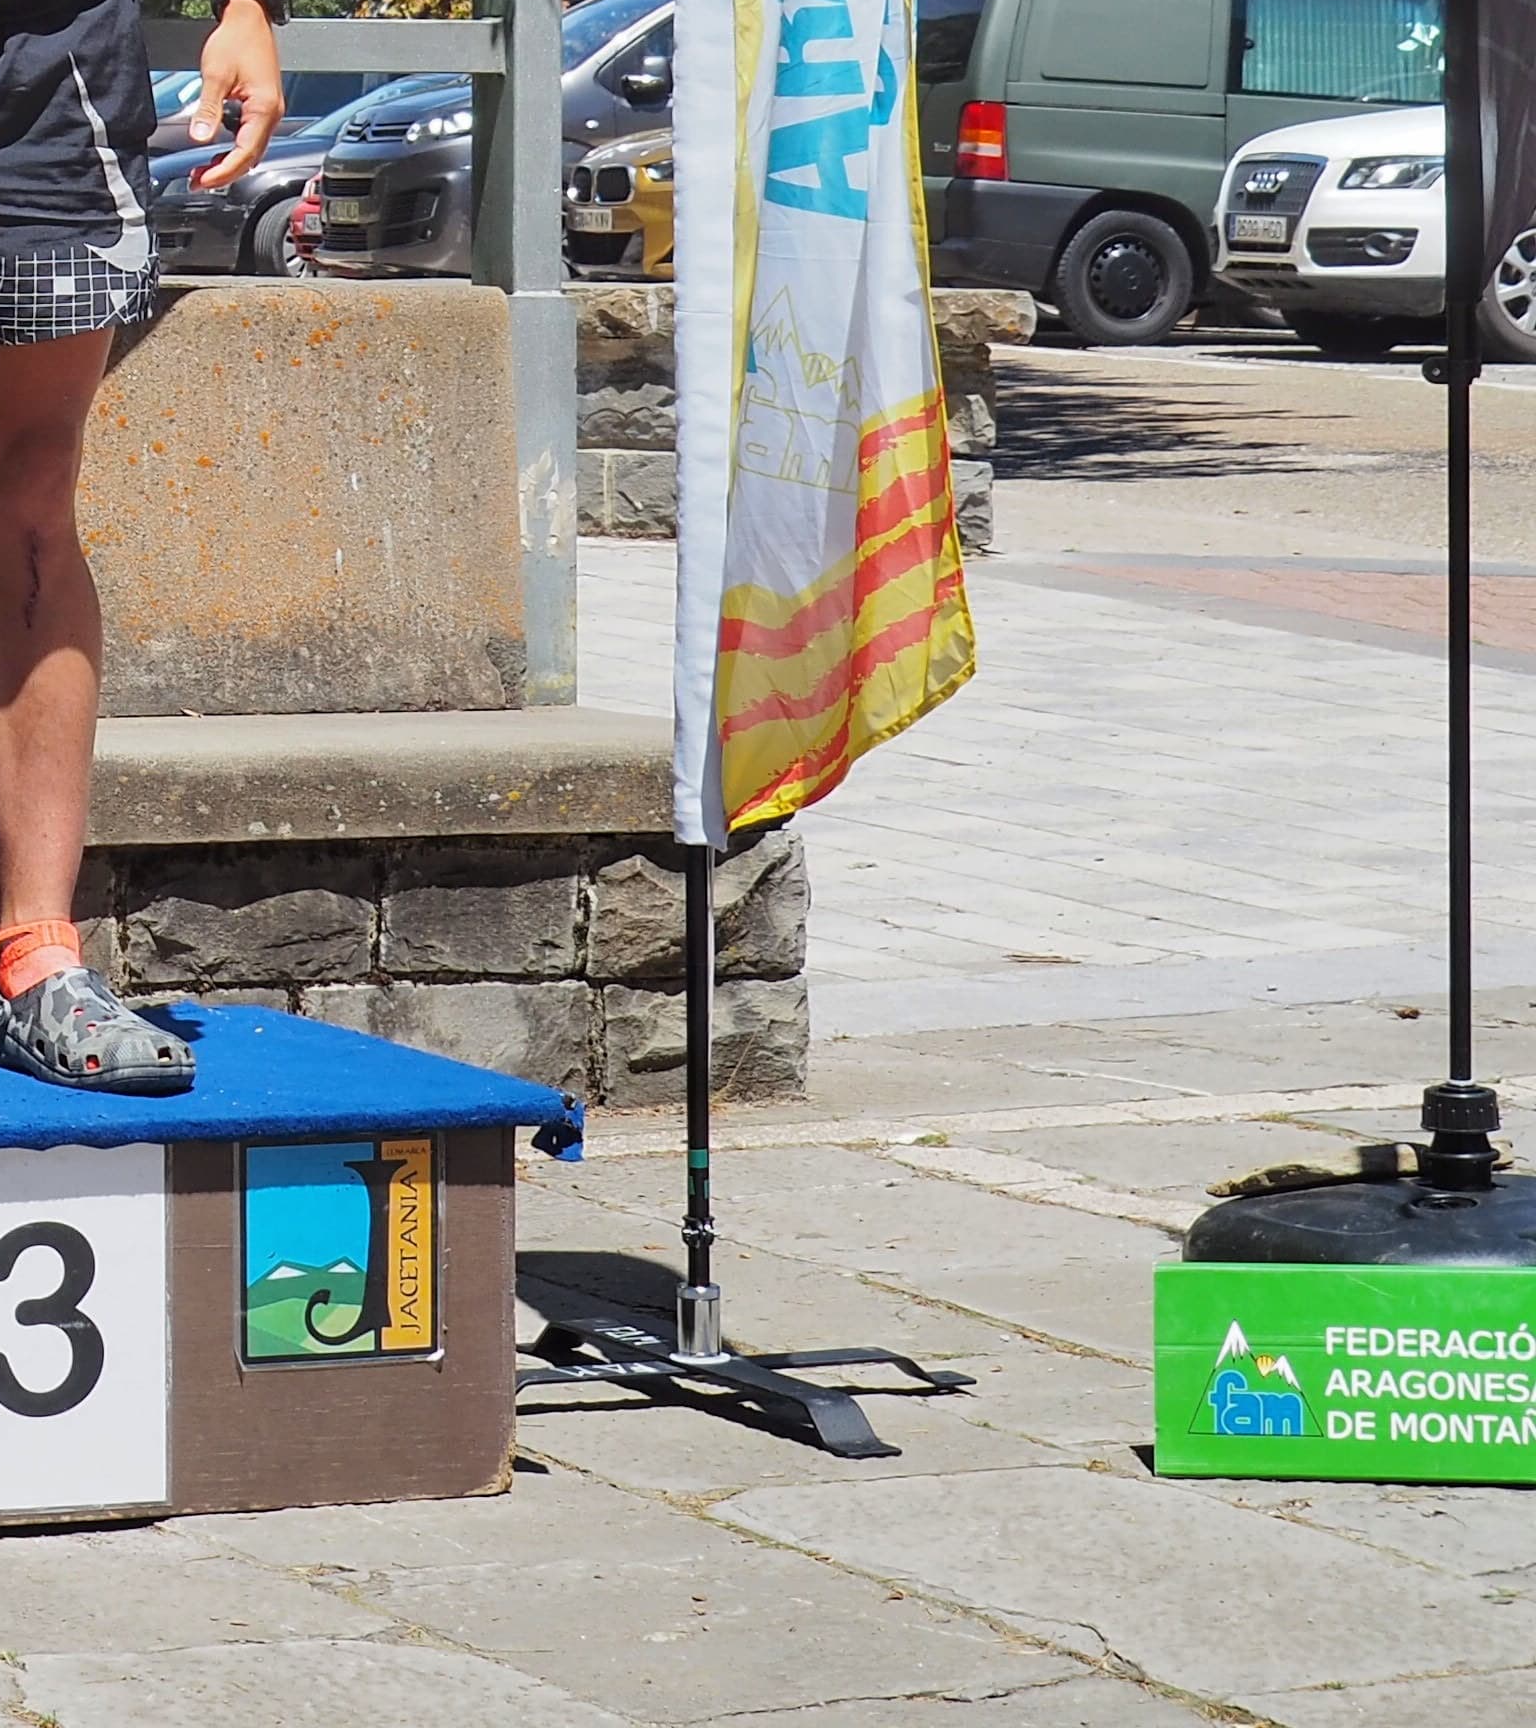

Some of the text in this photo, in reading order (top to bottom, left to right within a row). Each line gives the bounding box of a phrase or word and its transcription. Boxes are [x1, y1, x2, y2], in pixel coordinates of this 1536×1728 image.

[399, 1170, 421, 1334] JACETANIA
[1326, 1323, 1536, 1362] FEDERACIÓ
[1208, 1369, 1305, 1436] fam
[1326, 1370, 1536, 1404] ARAGONES
[1328, 1411, 1376, 1440] DE
